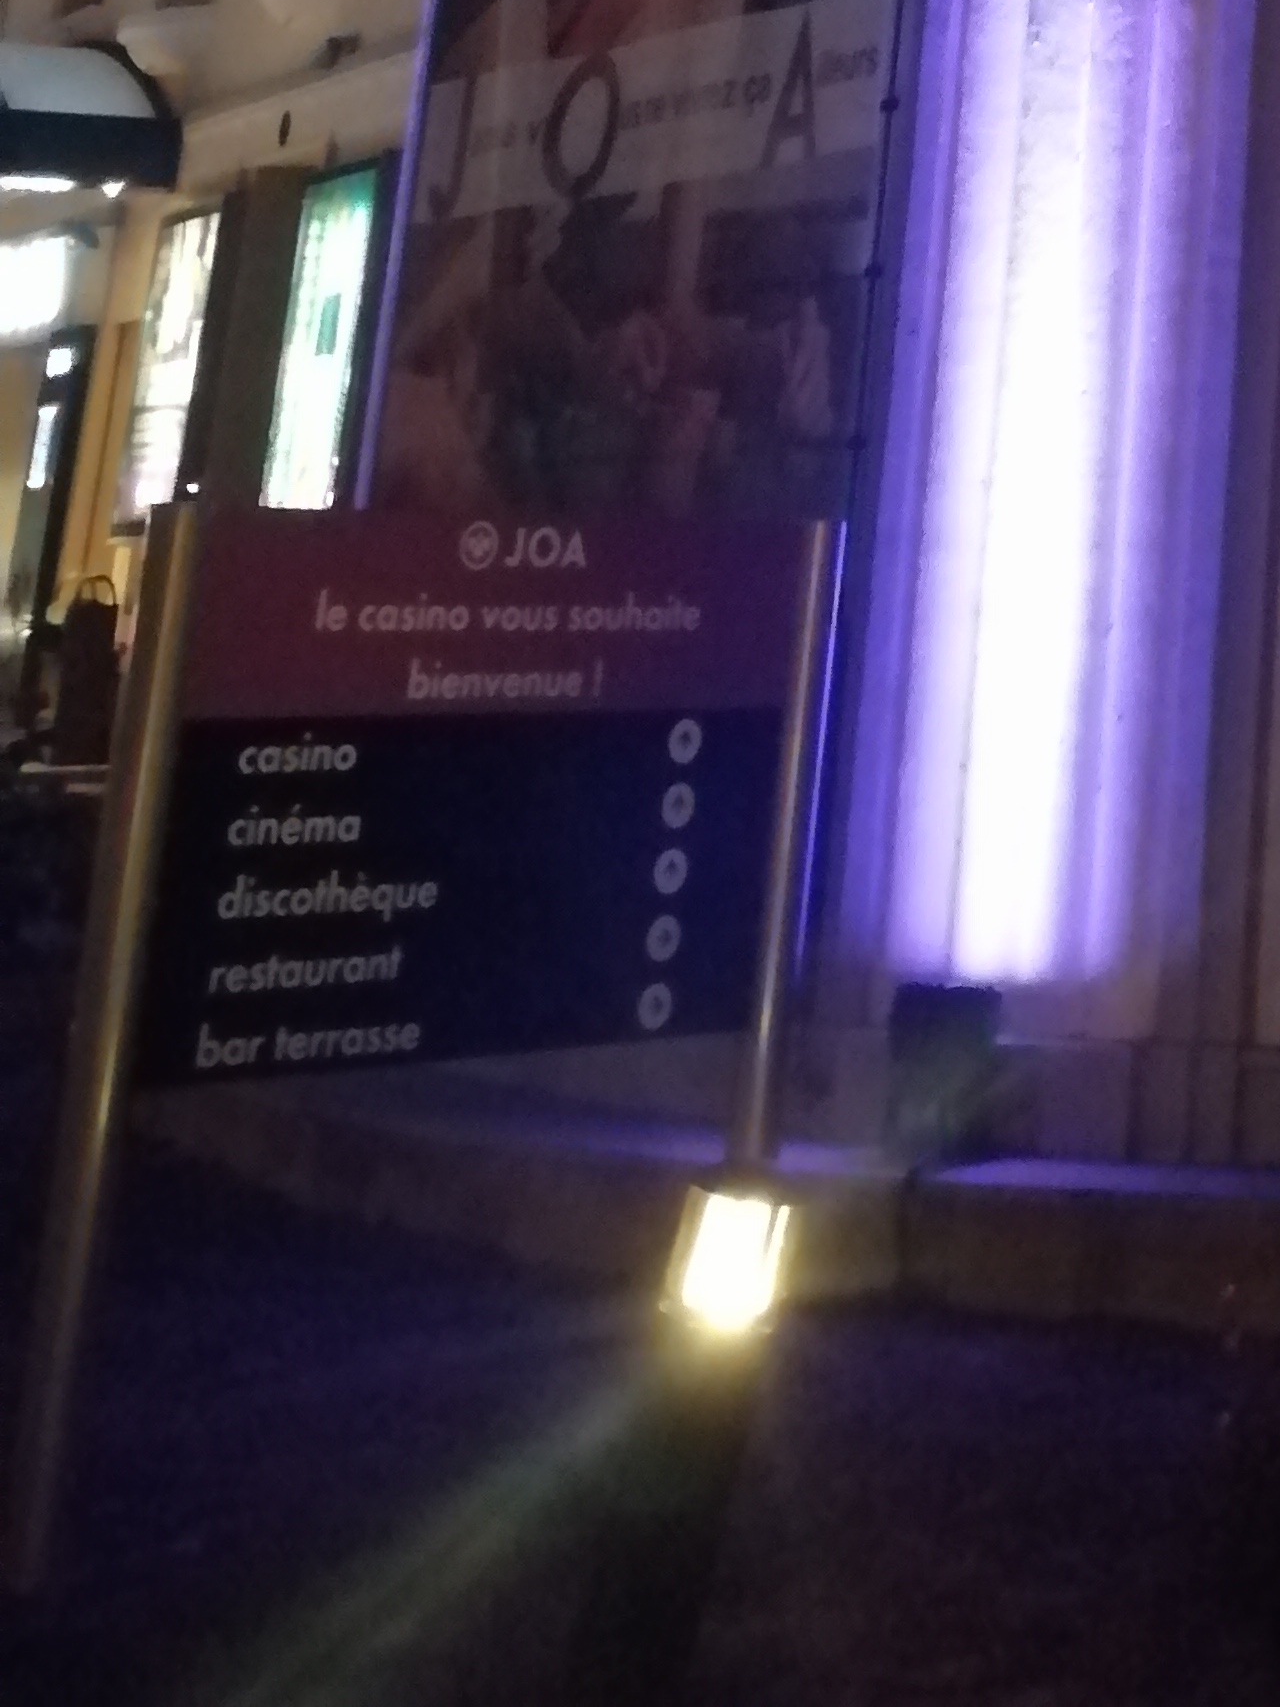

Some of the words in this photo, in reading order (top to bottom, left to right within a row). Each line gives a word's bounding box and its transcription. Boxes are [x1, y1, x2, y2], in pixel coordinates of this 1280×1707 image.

[505, 527, 587, 569] JOA
[314, 589, 348, 632] le
[357, 593, 470, 632] casino
[482, 604, 559, 631] vous
[568, 591, 702, 632] souhaite
[406, 658, 583, 699] bienvenue
[238, 731, 358, 775] casino
[226, 802, 363, 846] cinéma
[216, 869, 439, 923] discothèque
[207, 943, 405, 994] restaurant
[195, 1022, 266, 1069] bar
[274, 1021, 422, 1062] terrasse
